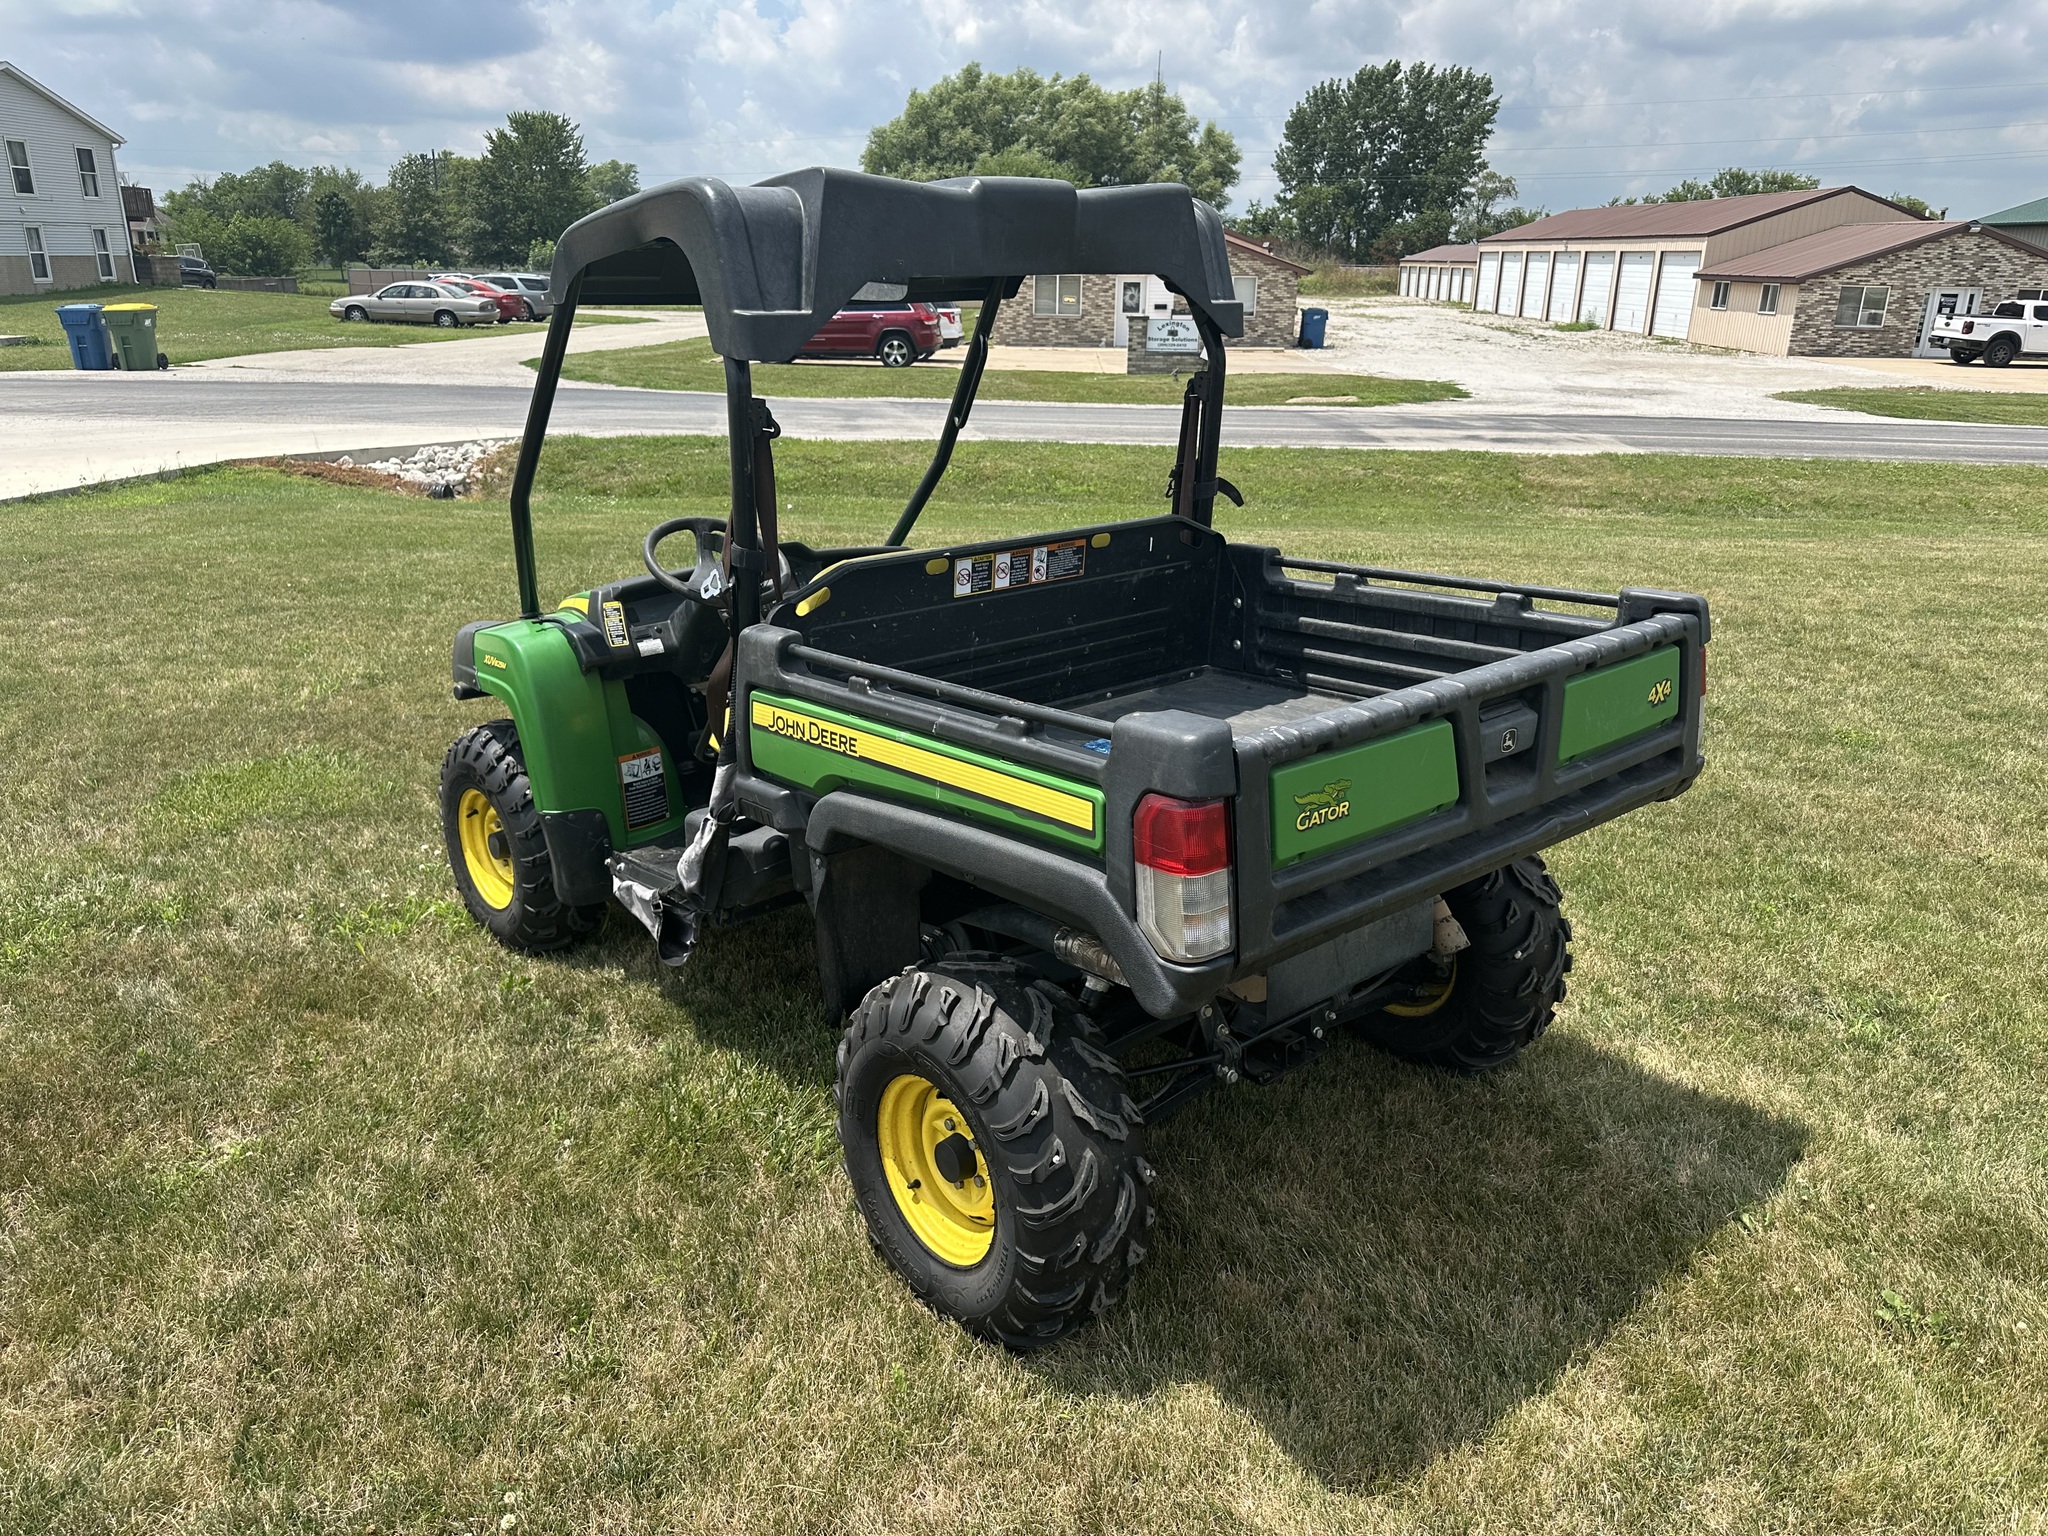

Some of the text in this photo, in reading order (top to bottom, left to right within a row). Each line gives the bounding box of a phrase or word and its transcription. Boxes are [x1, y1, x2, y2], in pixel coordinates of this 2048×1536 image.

[1157, 321, 1190, 332] Lexington
[1648, 680, 1671, 704] 4X4
[768, 711, 857, 754] JOHN DEERE
[1296, 801, 1350, 831] GATOR
